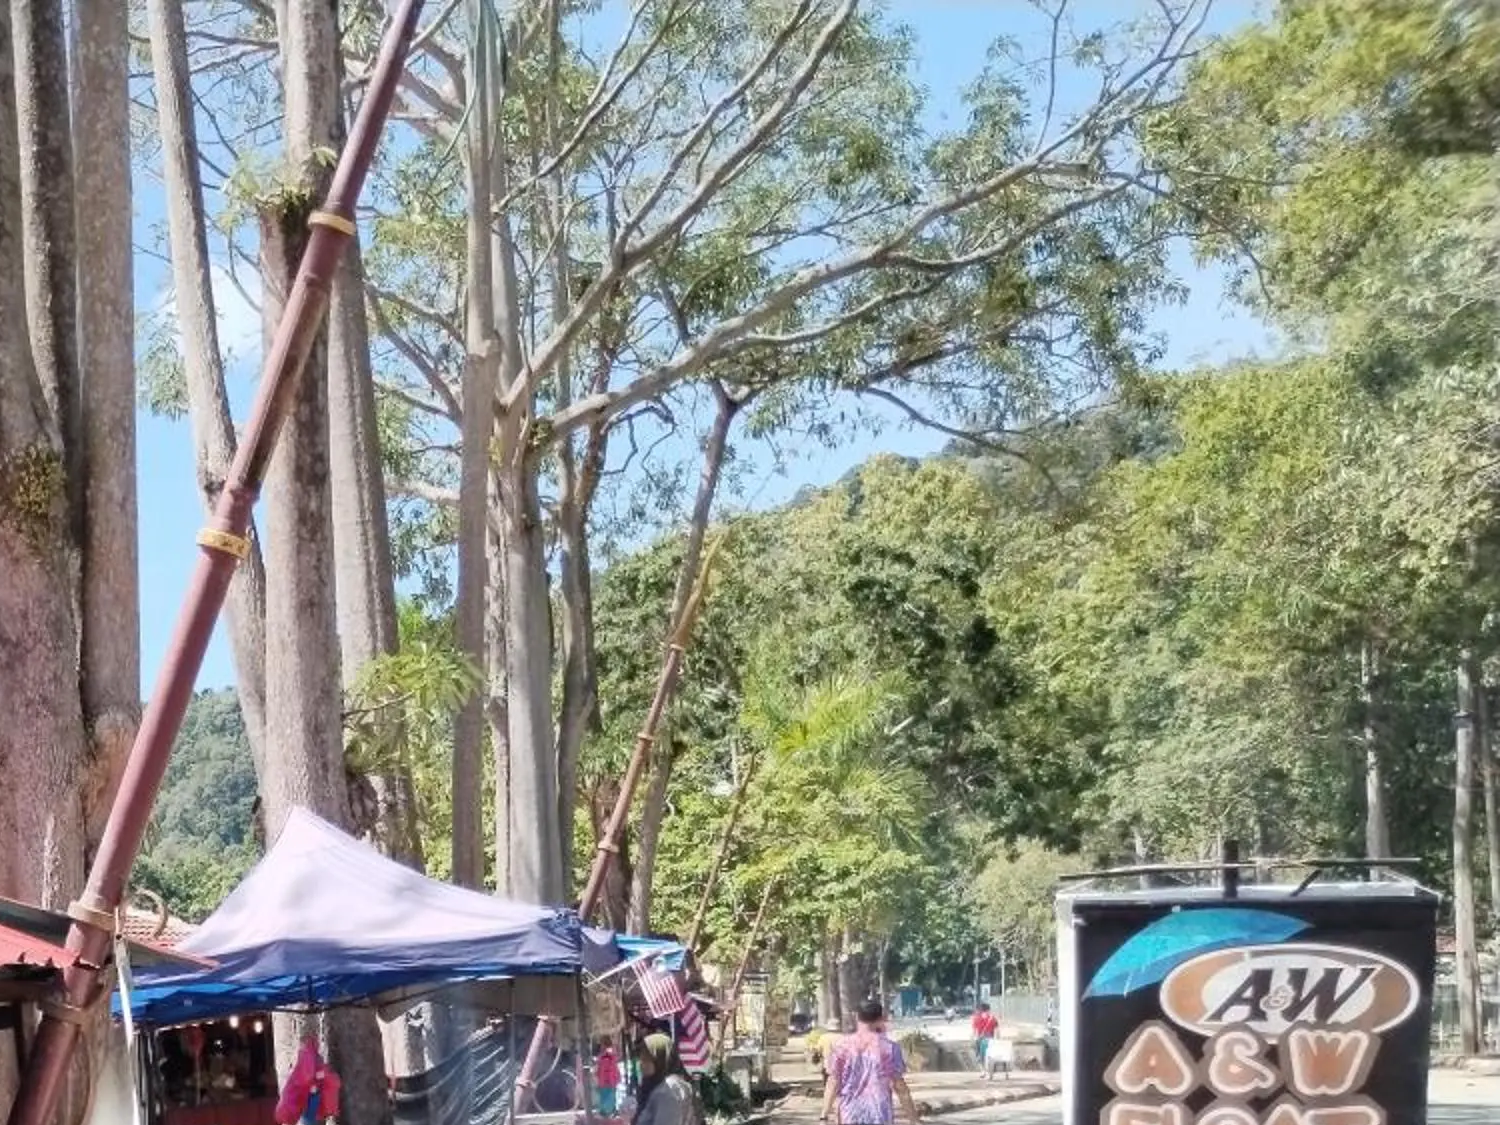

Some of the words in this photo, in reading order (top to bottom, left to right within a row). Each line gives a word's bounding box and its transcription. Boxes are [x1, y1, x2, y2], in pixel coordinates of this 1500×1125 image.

[1201, 965, 1380, 1025] A&W
[1112, 1024, 1194, 1096] A
[1208, 1029, 1277, 1096] &
[1287, 1028, 1370, 1097] W
